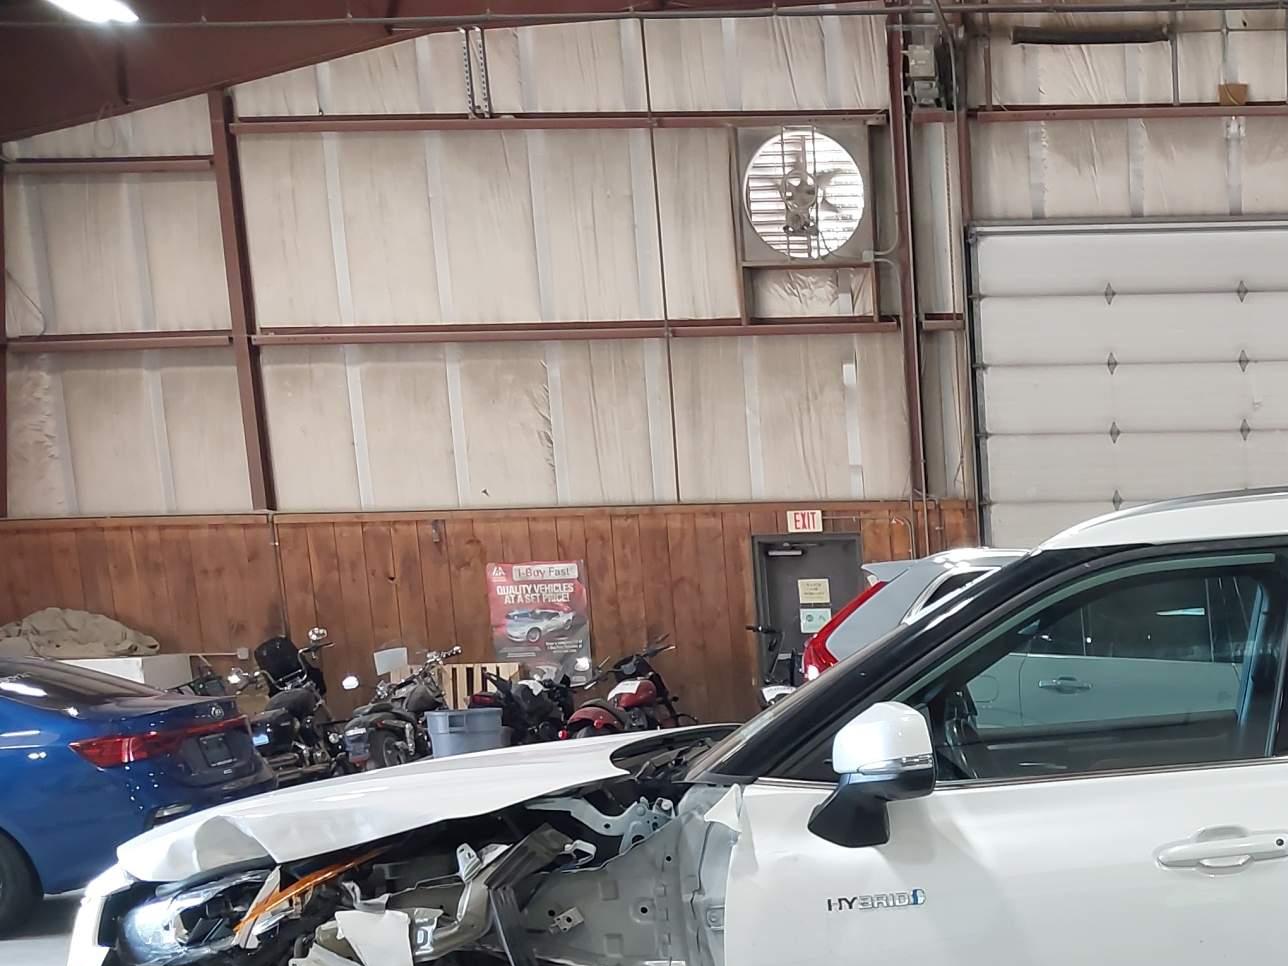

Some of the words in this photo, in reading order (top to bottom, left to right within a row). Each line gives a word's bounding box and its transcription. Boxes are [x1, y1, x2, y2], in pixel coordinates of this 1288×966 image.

[794, 512, 816, 530] EXIT
[549, 567, 570, 576] Fast
[496, 584, 532, 595] QUALITY
[533, 583, 574, 593] VEHICLES
[505, 595, 516, 604] AT
[517, 594, 524, 604] A
[525, 594, 540, 603] SET
[543, 593, 570, 603] PRICE!
[827, 891, 910, 911] HYBRID
